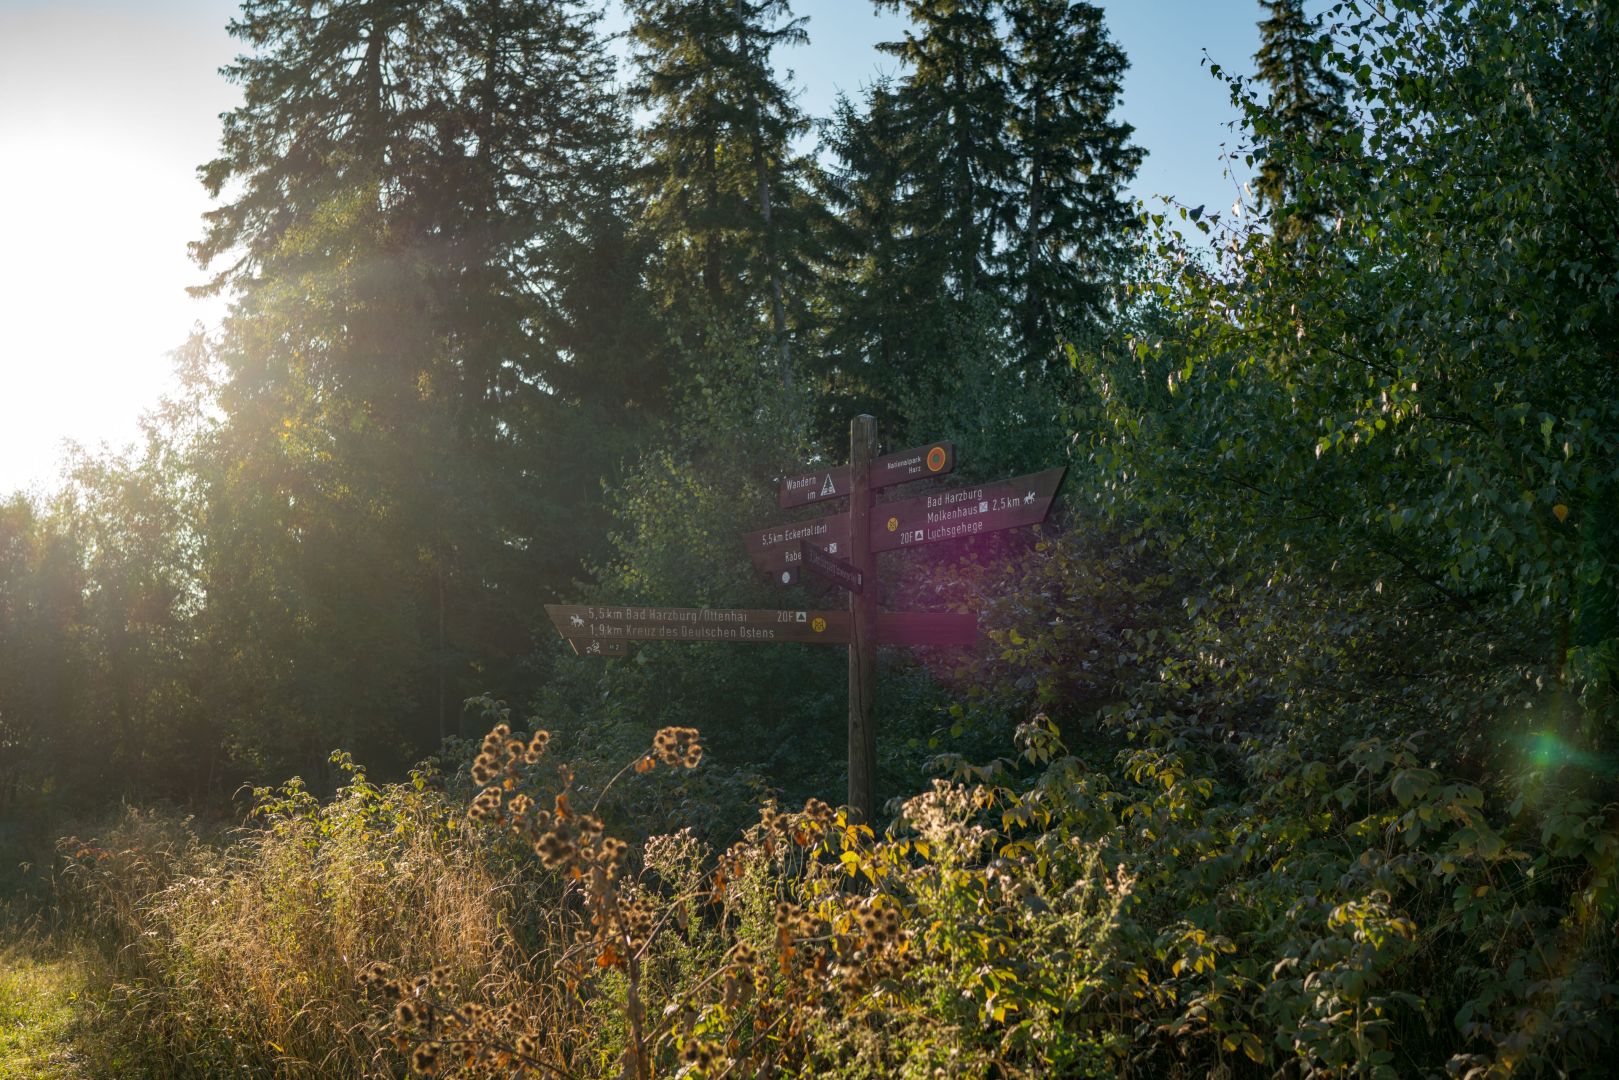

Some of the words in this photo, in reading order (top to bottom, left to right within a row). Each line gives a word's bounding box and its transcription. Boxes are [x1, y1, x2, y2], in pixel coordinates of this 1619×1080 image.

[908, 466, 921, 475] Harz
[786, 475, 817, 491] Wandern
[807, 490, 816, 500] im
[927, 496, 943, 508] Bad
[945, 489, 983, 504] Harzburg
[927, 506, 978, 524] Molkenhaus
[785, 525, 813, 541] Eckertal
[900, 531, 914, 545] 20F
[927, 520, 983, 542] Luchsgehege
[626, 608, 646, 620] Bad
[777, 610, 794, 623] 20F
[626, 625, 656, 636] Kreuz
[659, 625, 678, 637] des
[681, 625, 736, 638] Deutschen
[740, 626, 774, 639] Ostens
